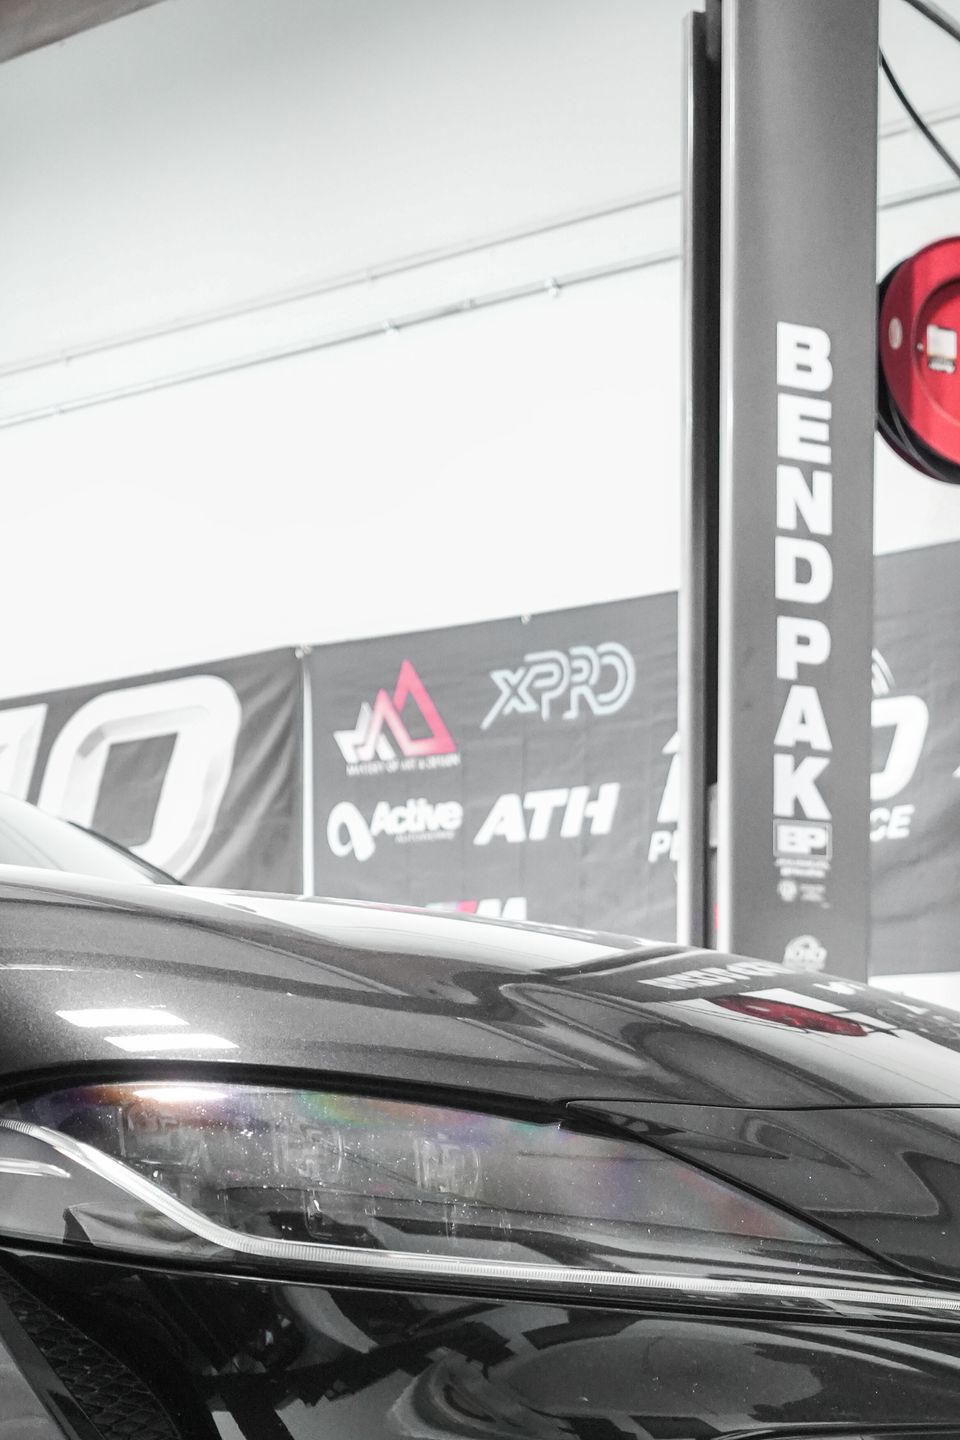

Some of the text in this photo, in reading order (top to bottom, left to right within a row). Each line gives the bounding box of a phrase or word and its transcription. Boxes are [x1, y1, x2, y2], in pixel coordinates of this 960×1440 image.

[774, 320, 833, 821] BENDPAK
[370, 797, 464, 837] Active
[473, 782, 621, 846] ATH
